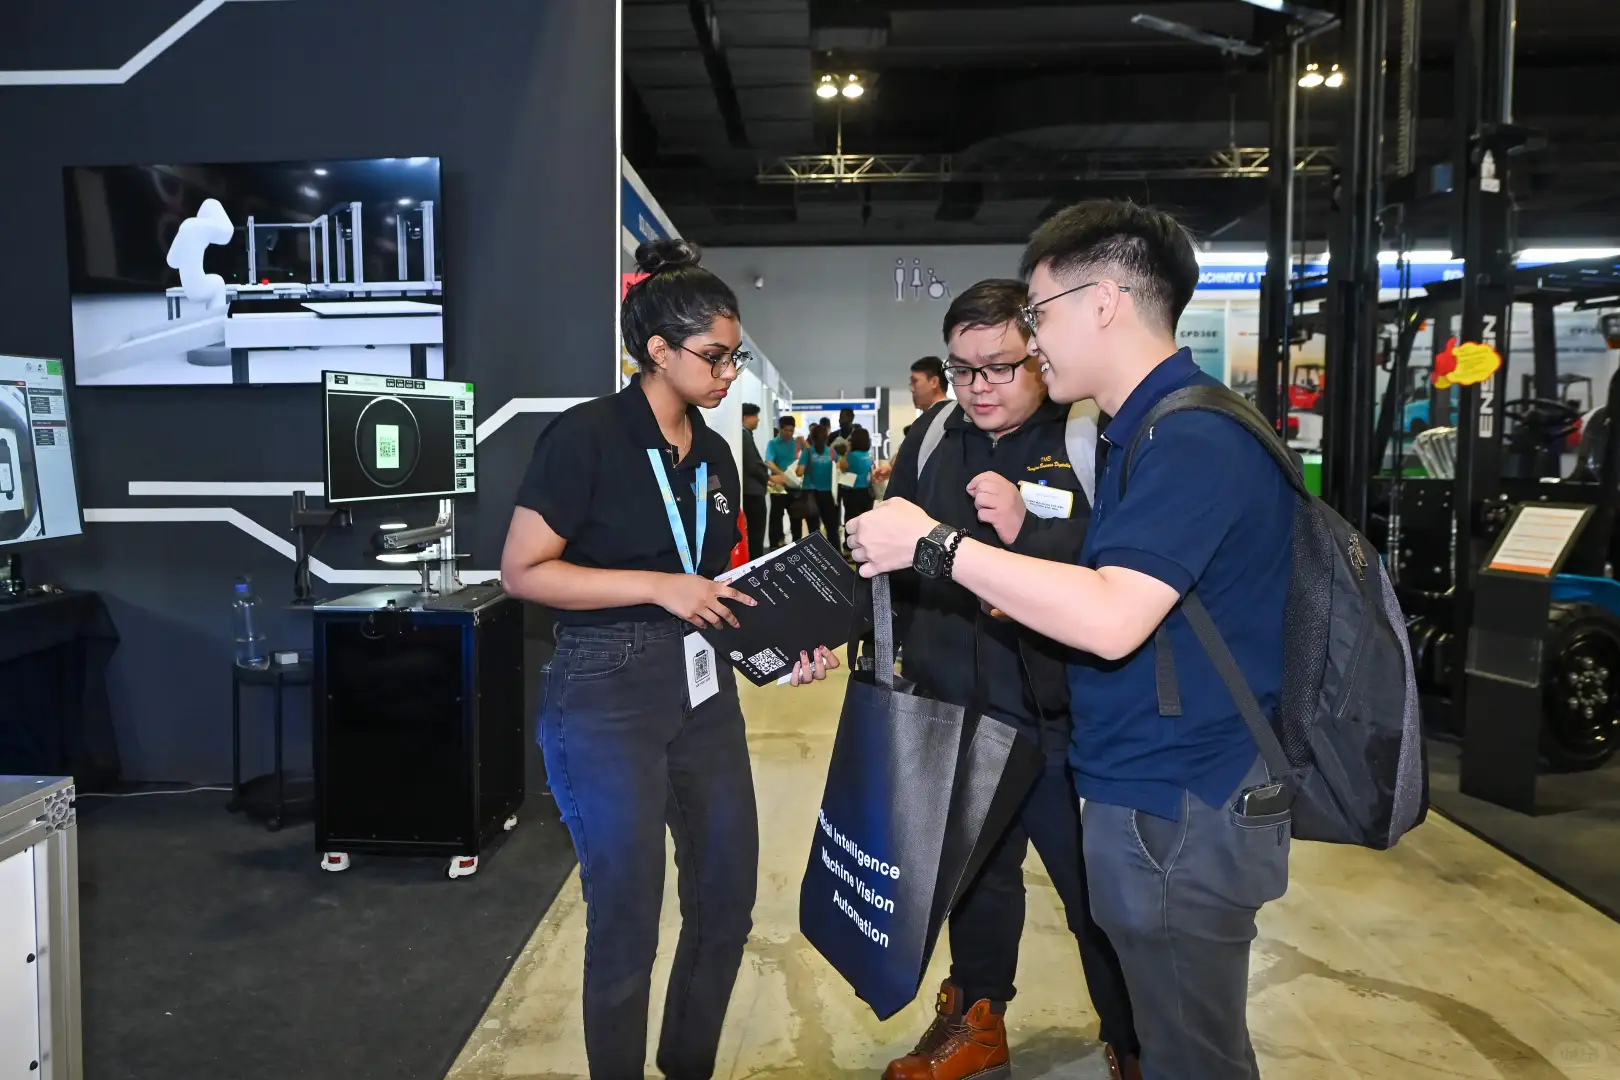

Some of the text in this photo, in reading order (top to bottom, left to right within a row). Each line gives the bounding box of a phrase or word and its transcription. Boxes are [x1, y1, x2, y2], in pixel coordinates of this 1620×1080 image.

[1198, 271, 1247, 284] ACHINERY
[821, 845, 895, 914] Machine Vision
[833, 827, 901, 880] Intelligence
[832, 889, 890, 948] Automation
